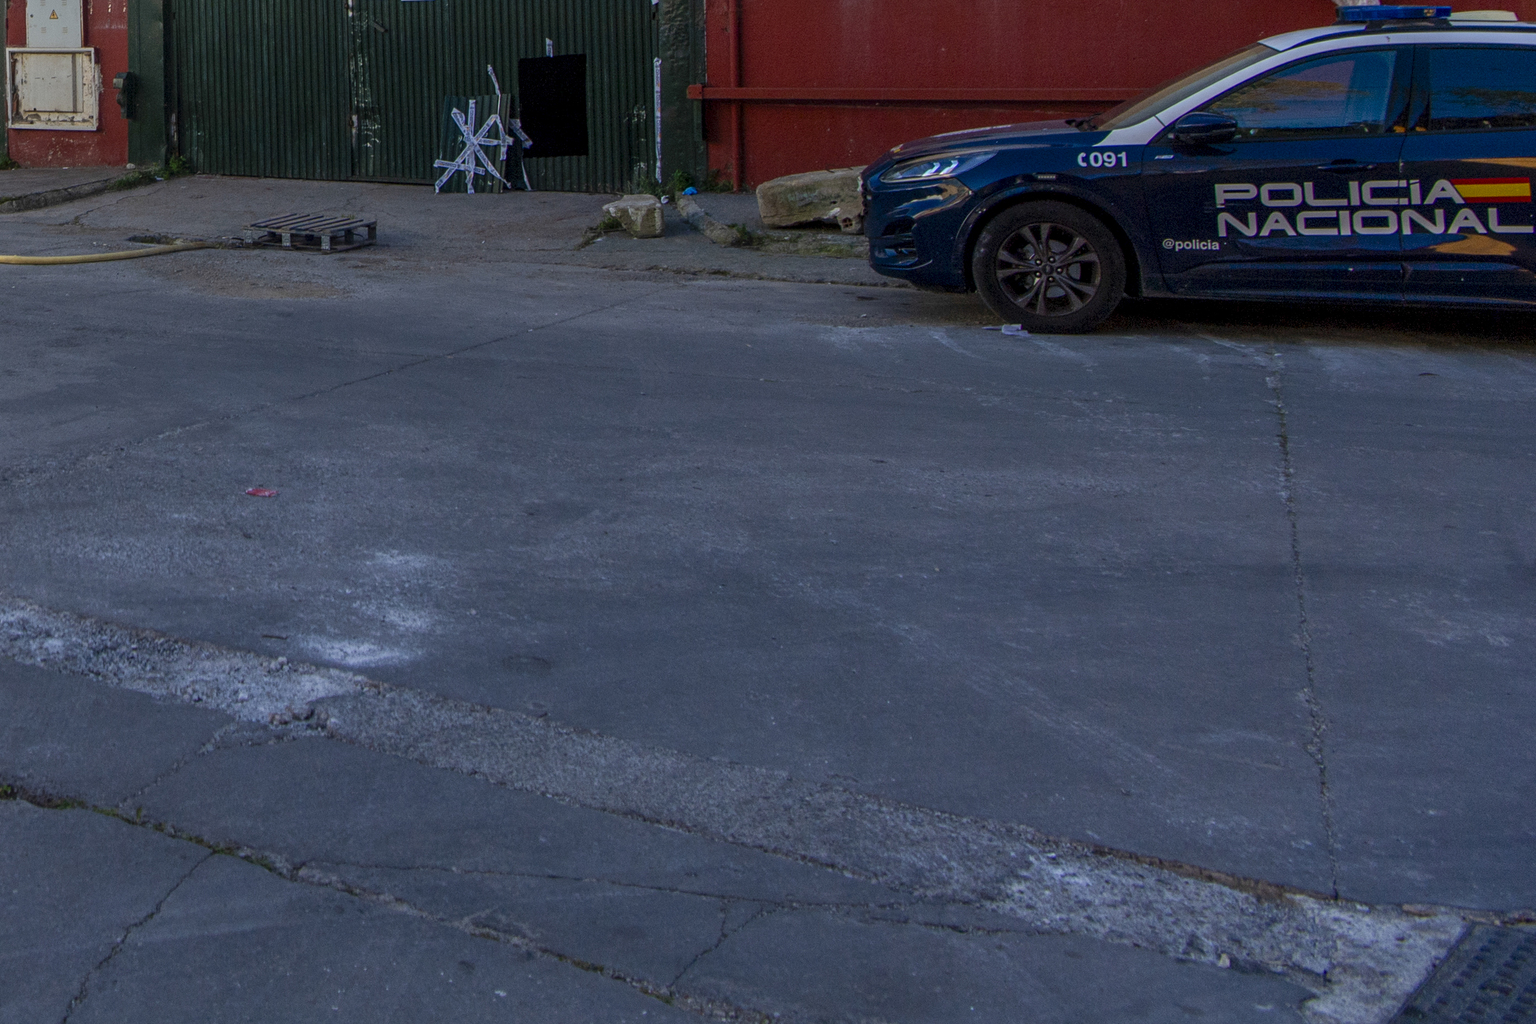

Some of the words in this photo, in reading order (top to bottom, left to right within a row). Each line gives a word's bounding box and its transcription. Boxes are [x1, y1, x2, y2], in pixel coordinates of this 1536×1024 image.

[1088, 151, 1128, 168] 091
[1217, 207, 1535, 237] NACIONAL
[1162, 238, 1221, 252] @policia
